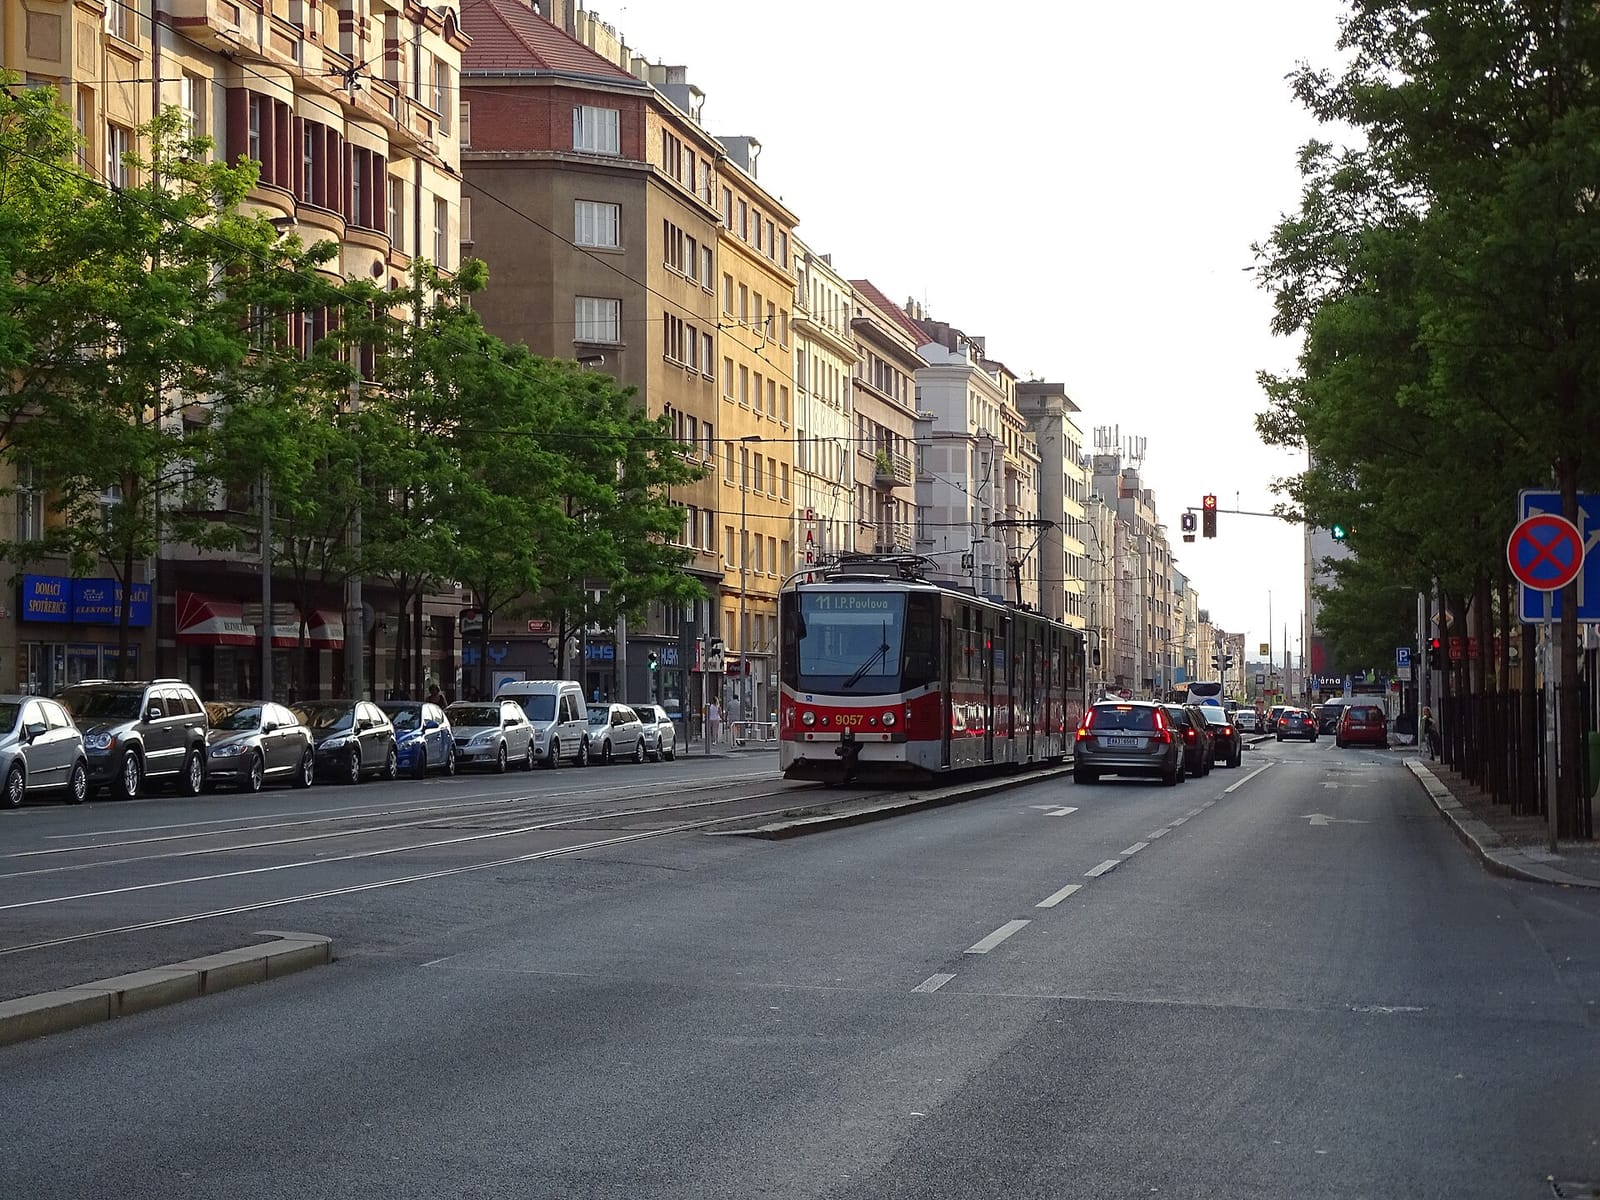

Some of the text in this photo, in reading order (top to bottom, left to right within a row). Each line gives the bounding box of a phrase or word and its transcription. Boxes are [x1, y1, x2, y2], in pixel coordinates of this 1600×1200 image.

[816, 596, 830, 609] 11
[1399, 650, 1408, 661] P
[835, 714, 864, 725] 9057
